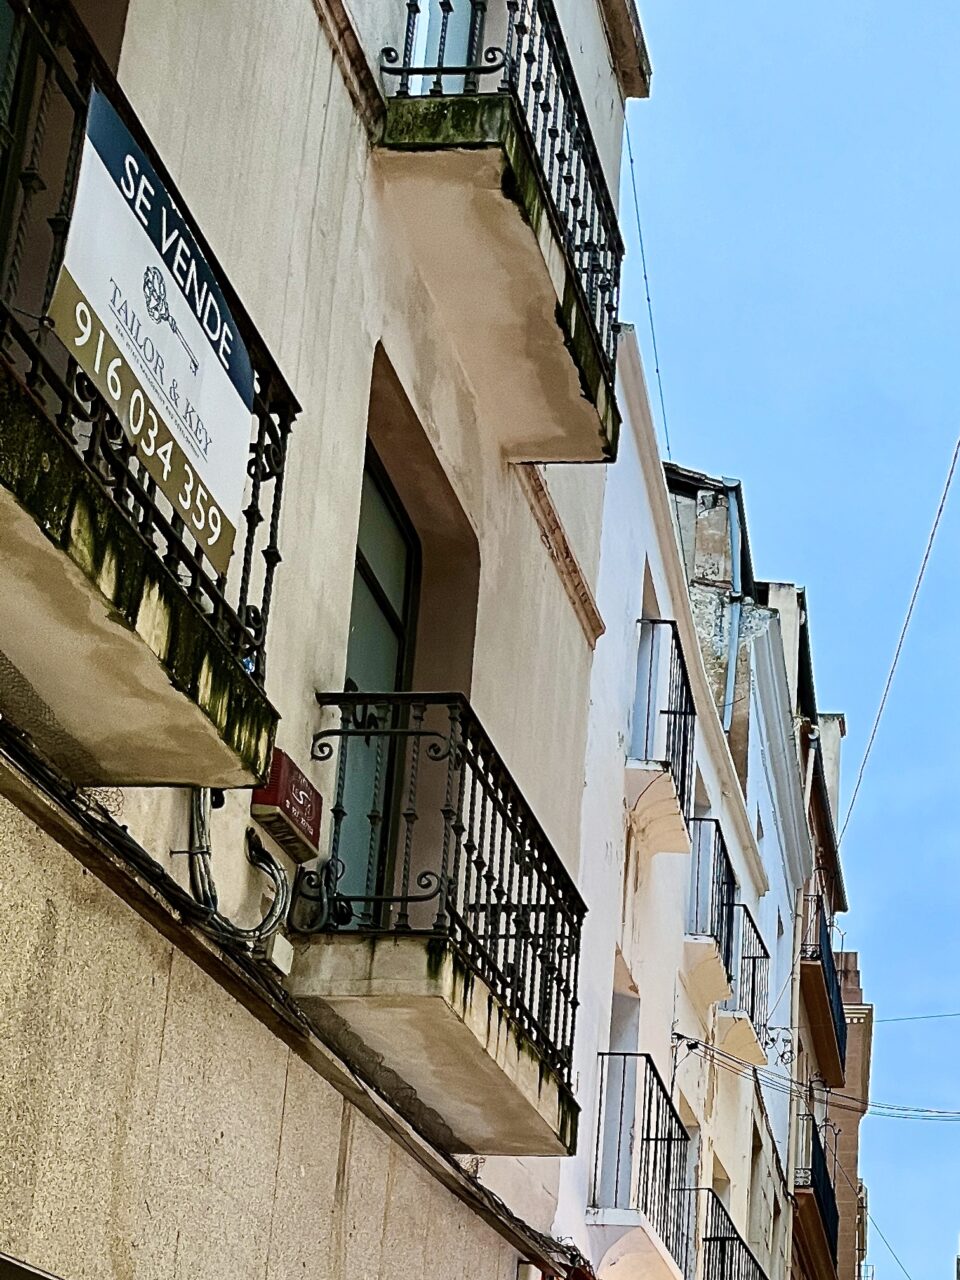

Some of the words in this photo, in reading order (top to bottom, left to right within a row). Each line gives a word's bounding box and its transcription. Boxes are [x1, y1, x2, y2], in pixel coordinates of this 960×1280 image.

[110, 276, 164, 385] TAILOR
[169, 378, 179, 409] &
[183, 402, 213, 456] KEY
[120, 154, 154, 226] SE
[161, 206, 233, 371] VENDE
[73, 301, 121, 400] 916
[129, 388, 174, 482] 034
[178, 463, 222, 546] 359
